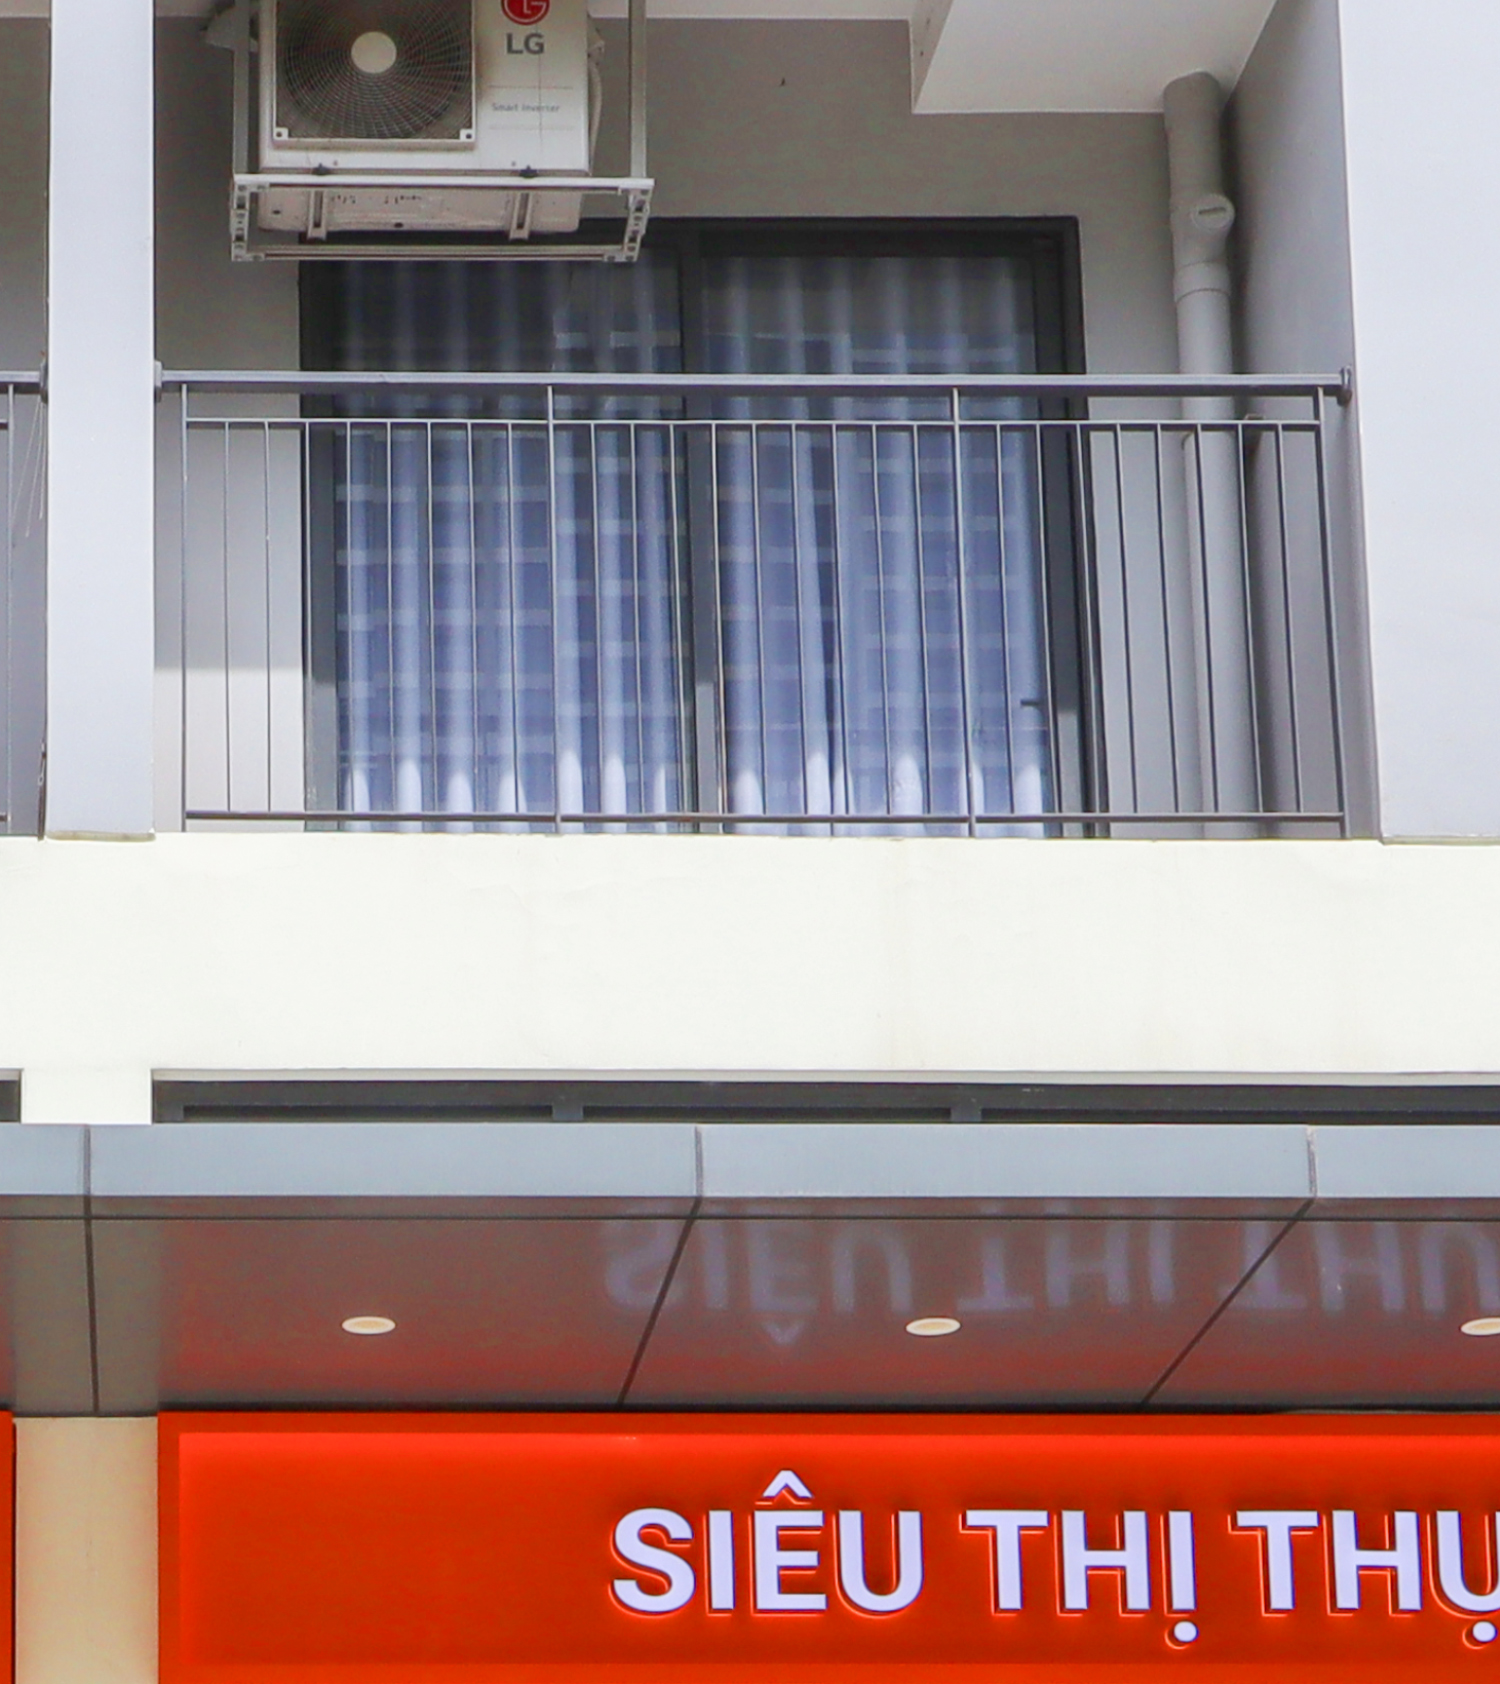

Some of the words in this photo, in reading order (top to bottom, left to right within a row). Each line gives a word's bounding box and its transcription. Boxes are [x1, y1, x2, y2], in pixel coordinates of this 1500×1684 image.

[506, 33, 545, 55] LG
[492, 102, 525, 113] Smart
[610, 1470, 925, 1616] SIÊU
[961, 1510, 1198, 1648] THỊ
